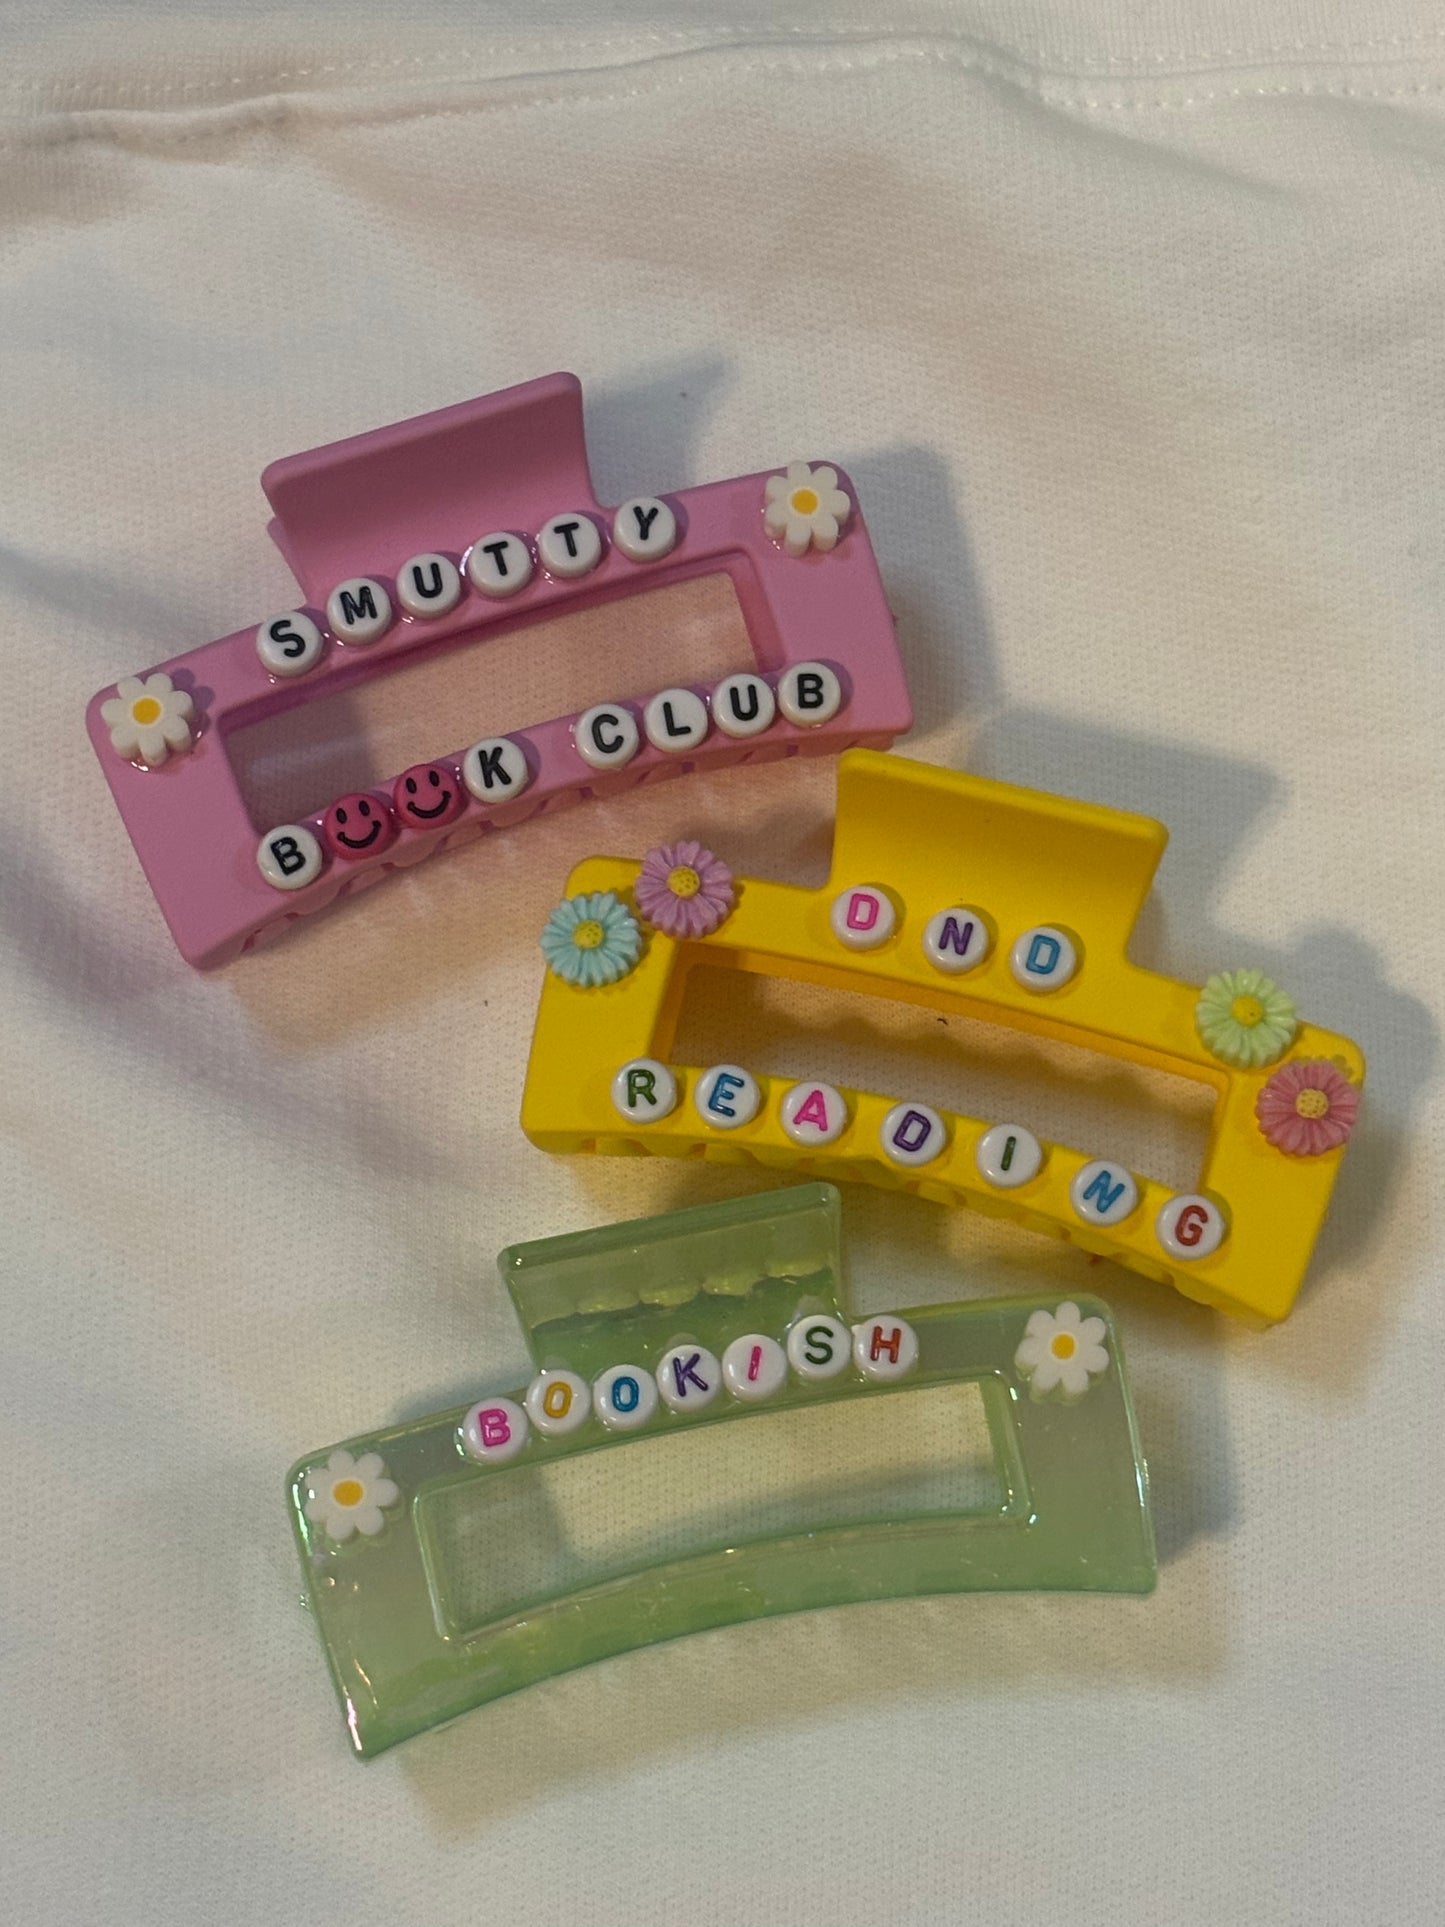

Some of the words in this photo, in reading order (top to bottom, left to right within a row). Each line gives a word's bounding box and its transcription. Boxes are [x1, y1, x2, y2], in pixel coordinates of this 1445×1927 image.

[269, 506, 659, 657] SMUTTY
[591, 672, 824, 755] CLUB
[846, 892, 1061, 976] DND
[626, 1067, 1208, 1247] READING
[478, 1324, 901, 1447] BOOKISH
